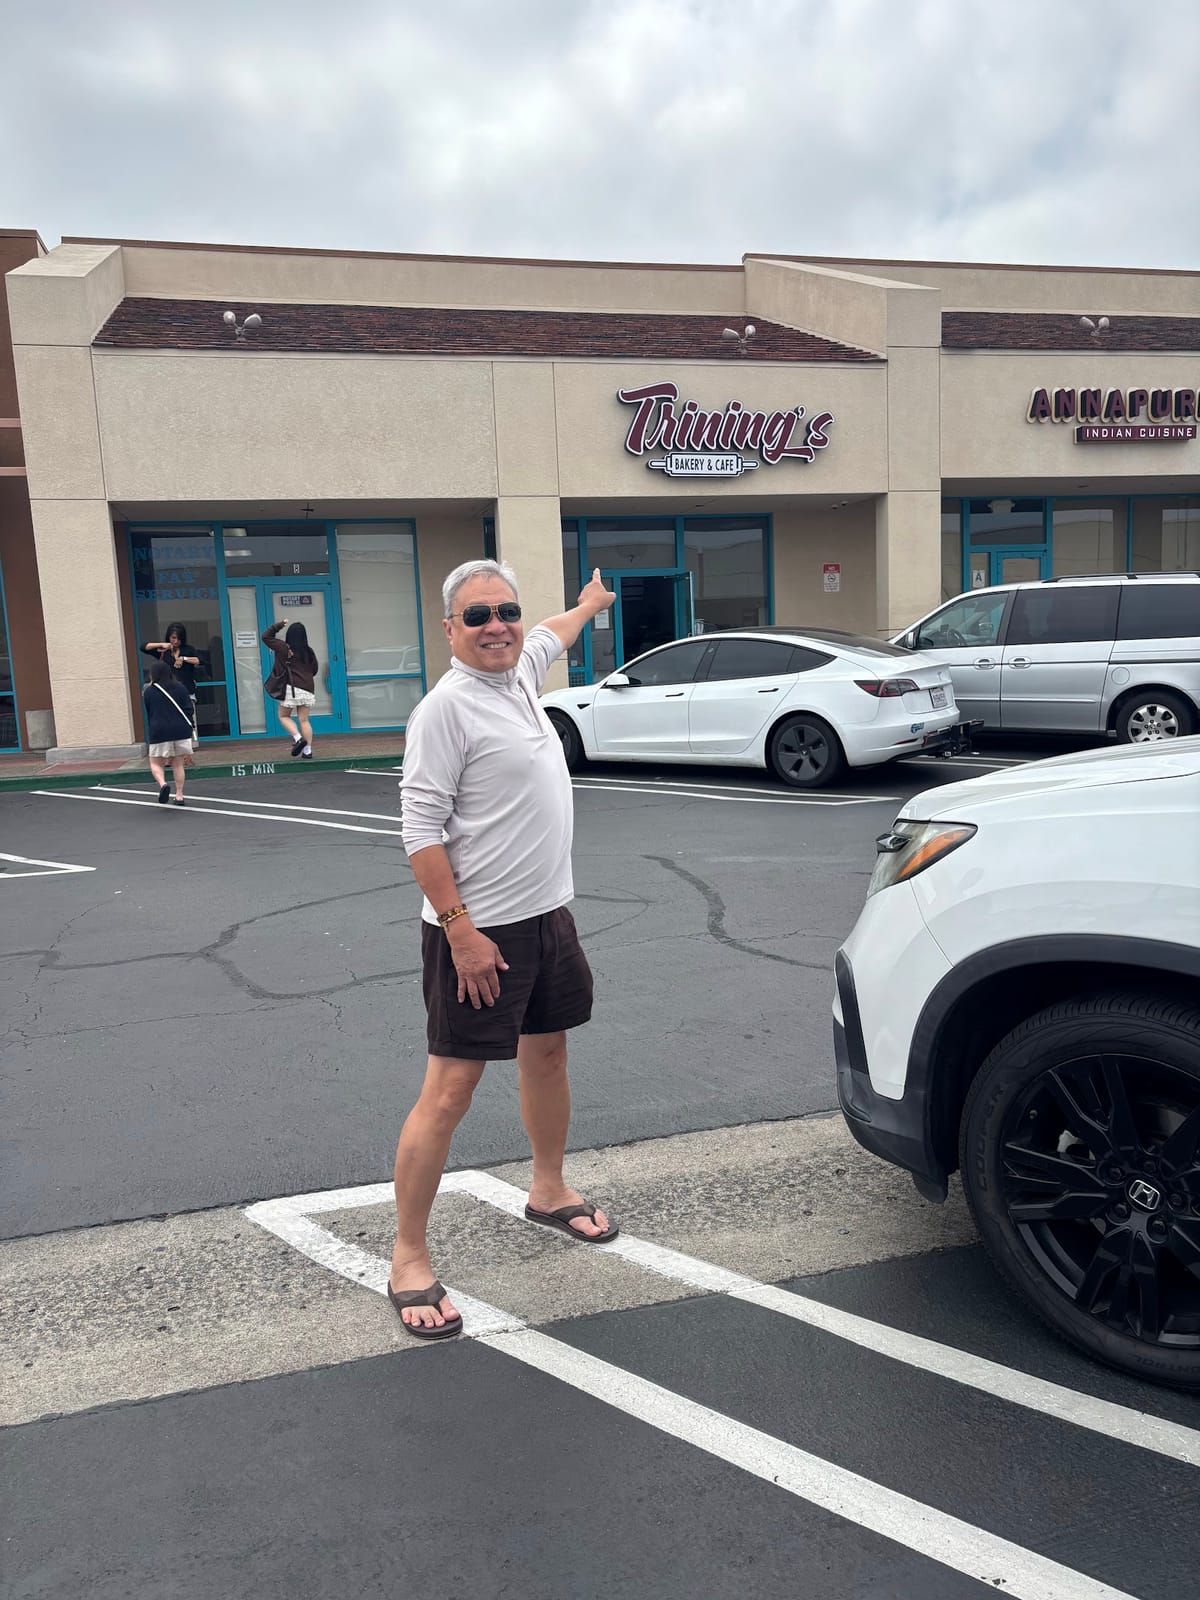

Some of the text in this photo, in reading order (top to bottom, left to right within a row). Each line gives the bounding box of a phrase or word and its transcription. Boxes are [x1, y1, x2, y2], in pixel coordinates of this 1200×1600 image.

[1026, 386, 1200, 424] ANNAPUR
[617, 381, 834, 464] Trining's
[1086, 427, 1193, 438] INDIAN CUISINE
[674, 458, 734, 472] BAKERY & CAFE
[231, 763, 275, 777] 15 MIN
